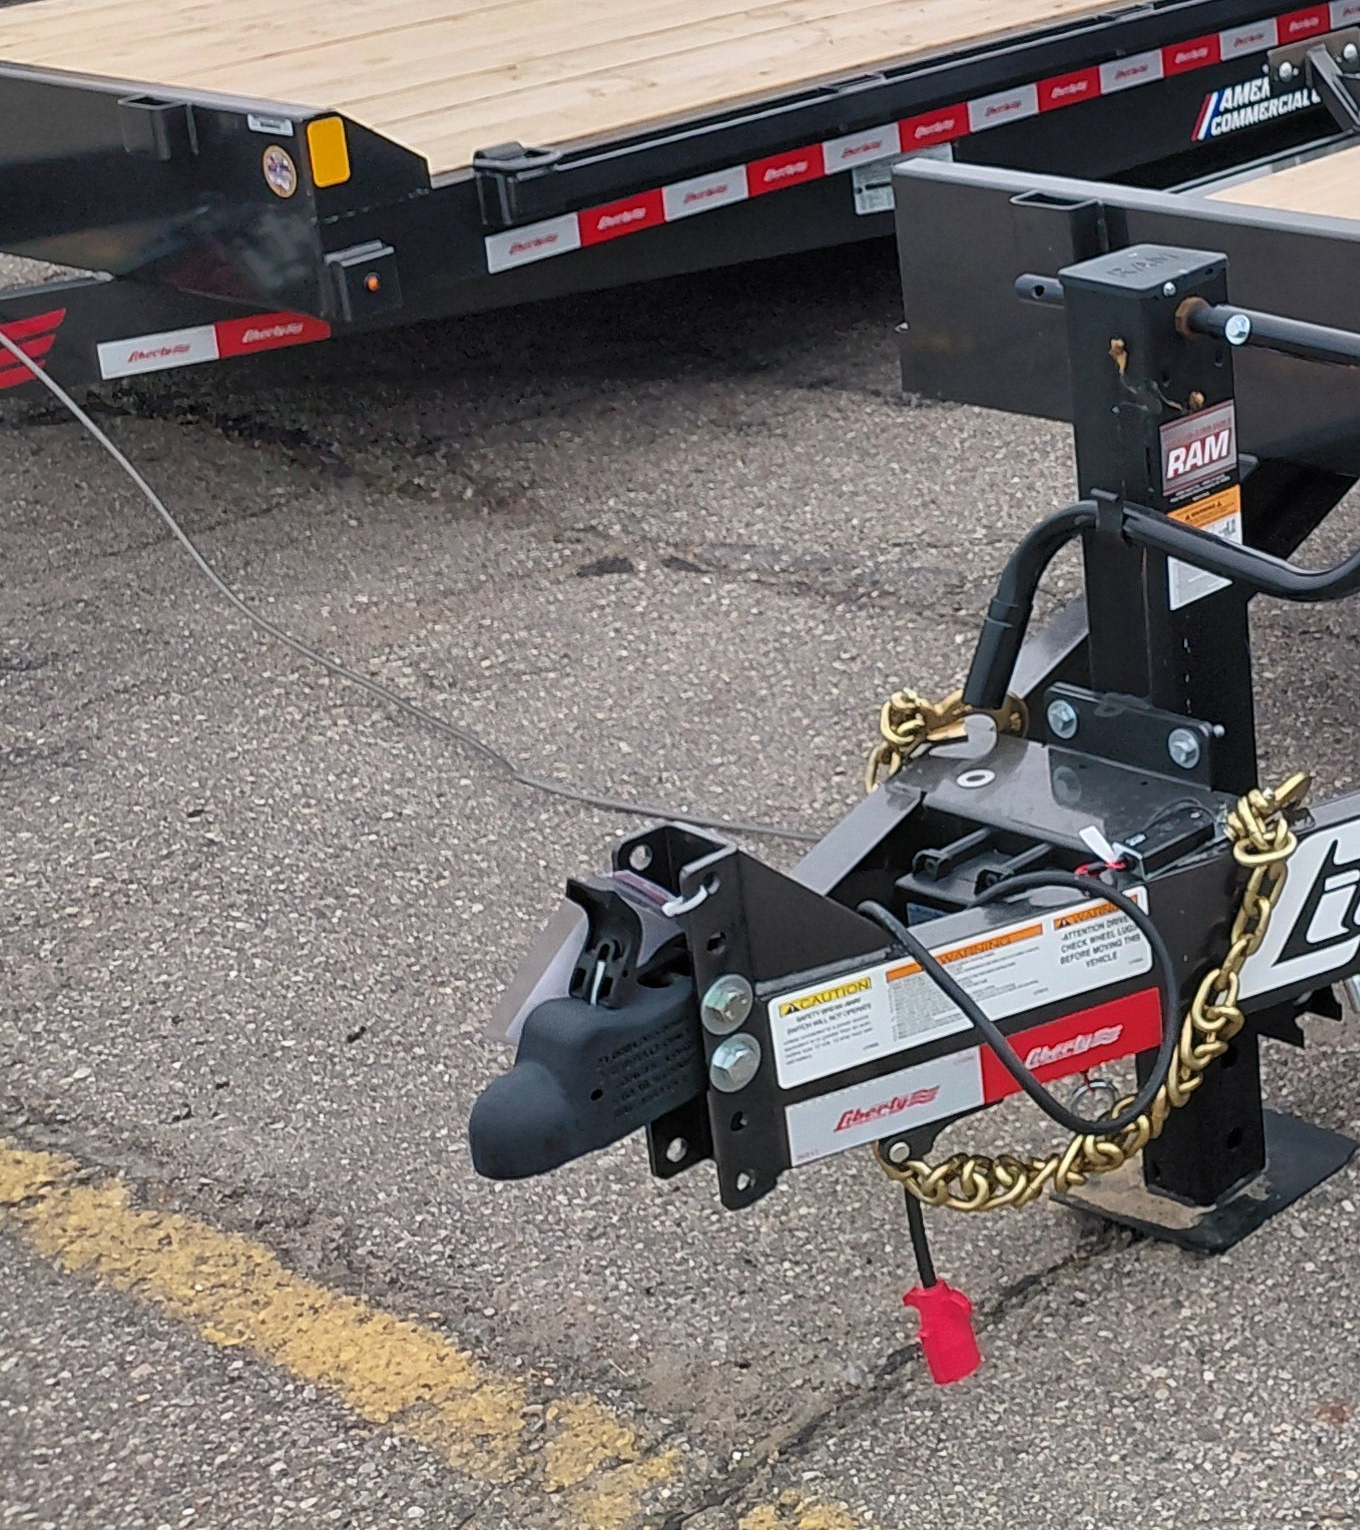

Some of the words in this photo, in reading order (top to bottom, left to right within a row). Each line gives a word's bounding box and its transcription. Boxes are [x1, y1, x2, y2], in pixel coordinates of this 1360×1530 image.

[1211, 87, 1310, 136] COMMERCIAL
[1166, 429, 1230, 479] RAM
[1060, 939, 1088, 953] CHECK
[1089, 931, 1116, 944] WHEEL
[1062, 922, 1105, 941] ATTENTION
[1106, 916, 1129, 928] DRIVE
[1060, 949, 1091, 965] BEFORE
[1093, 940, 1123, 954] MOVING
[1124, 933, 1141, 945] THIS
[1085, 951, 1118, 967] VEHICLE
[800, 977, 870, 1009] CAUTION
[834, 1092, 907, 1132] Liberty
